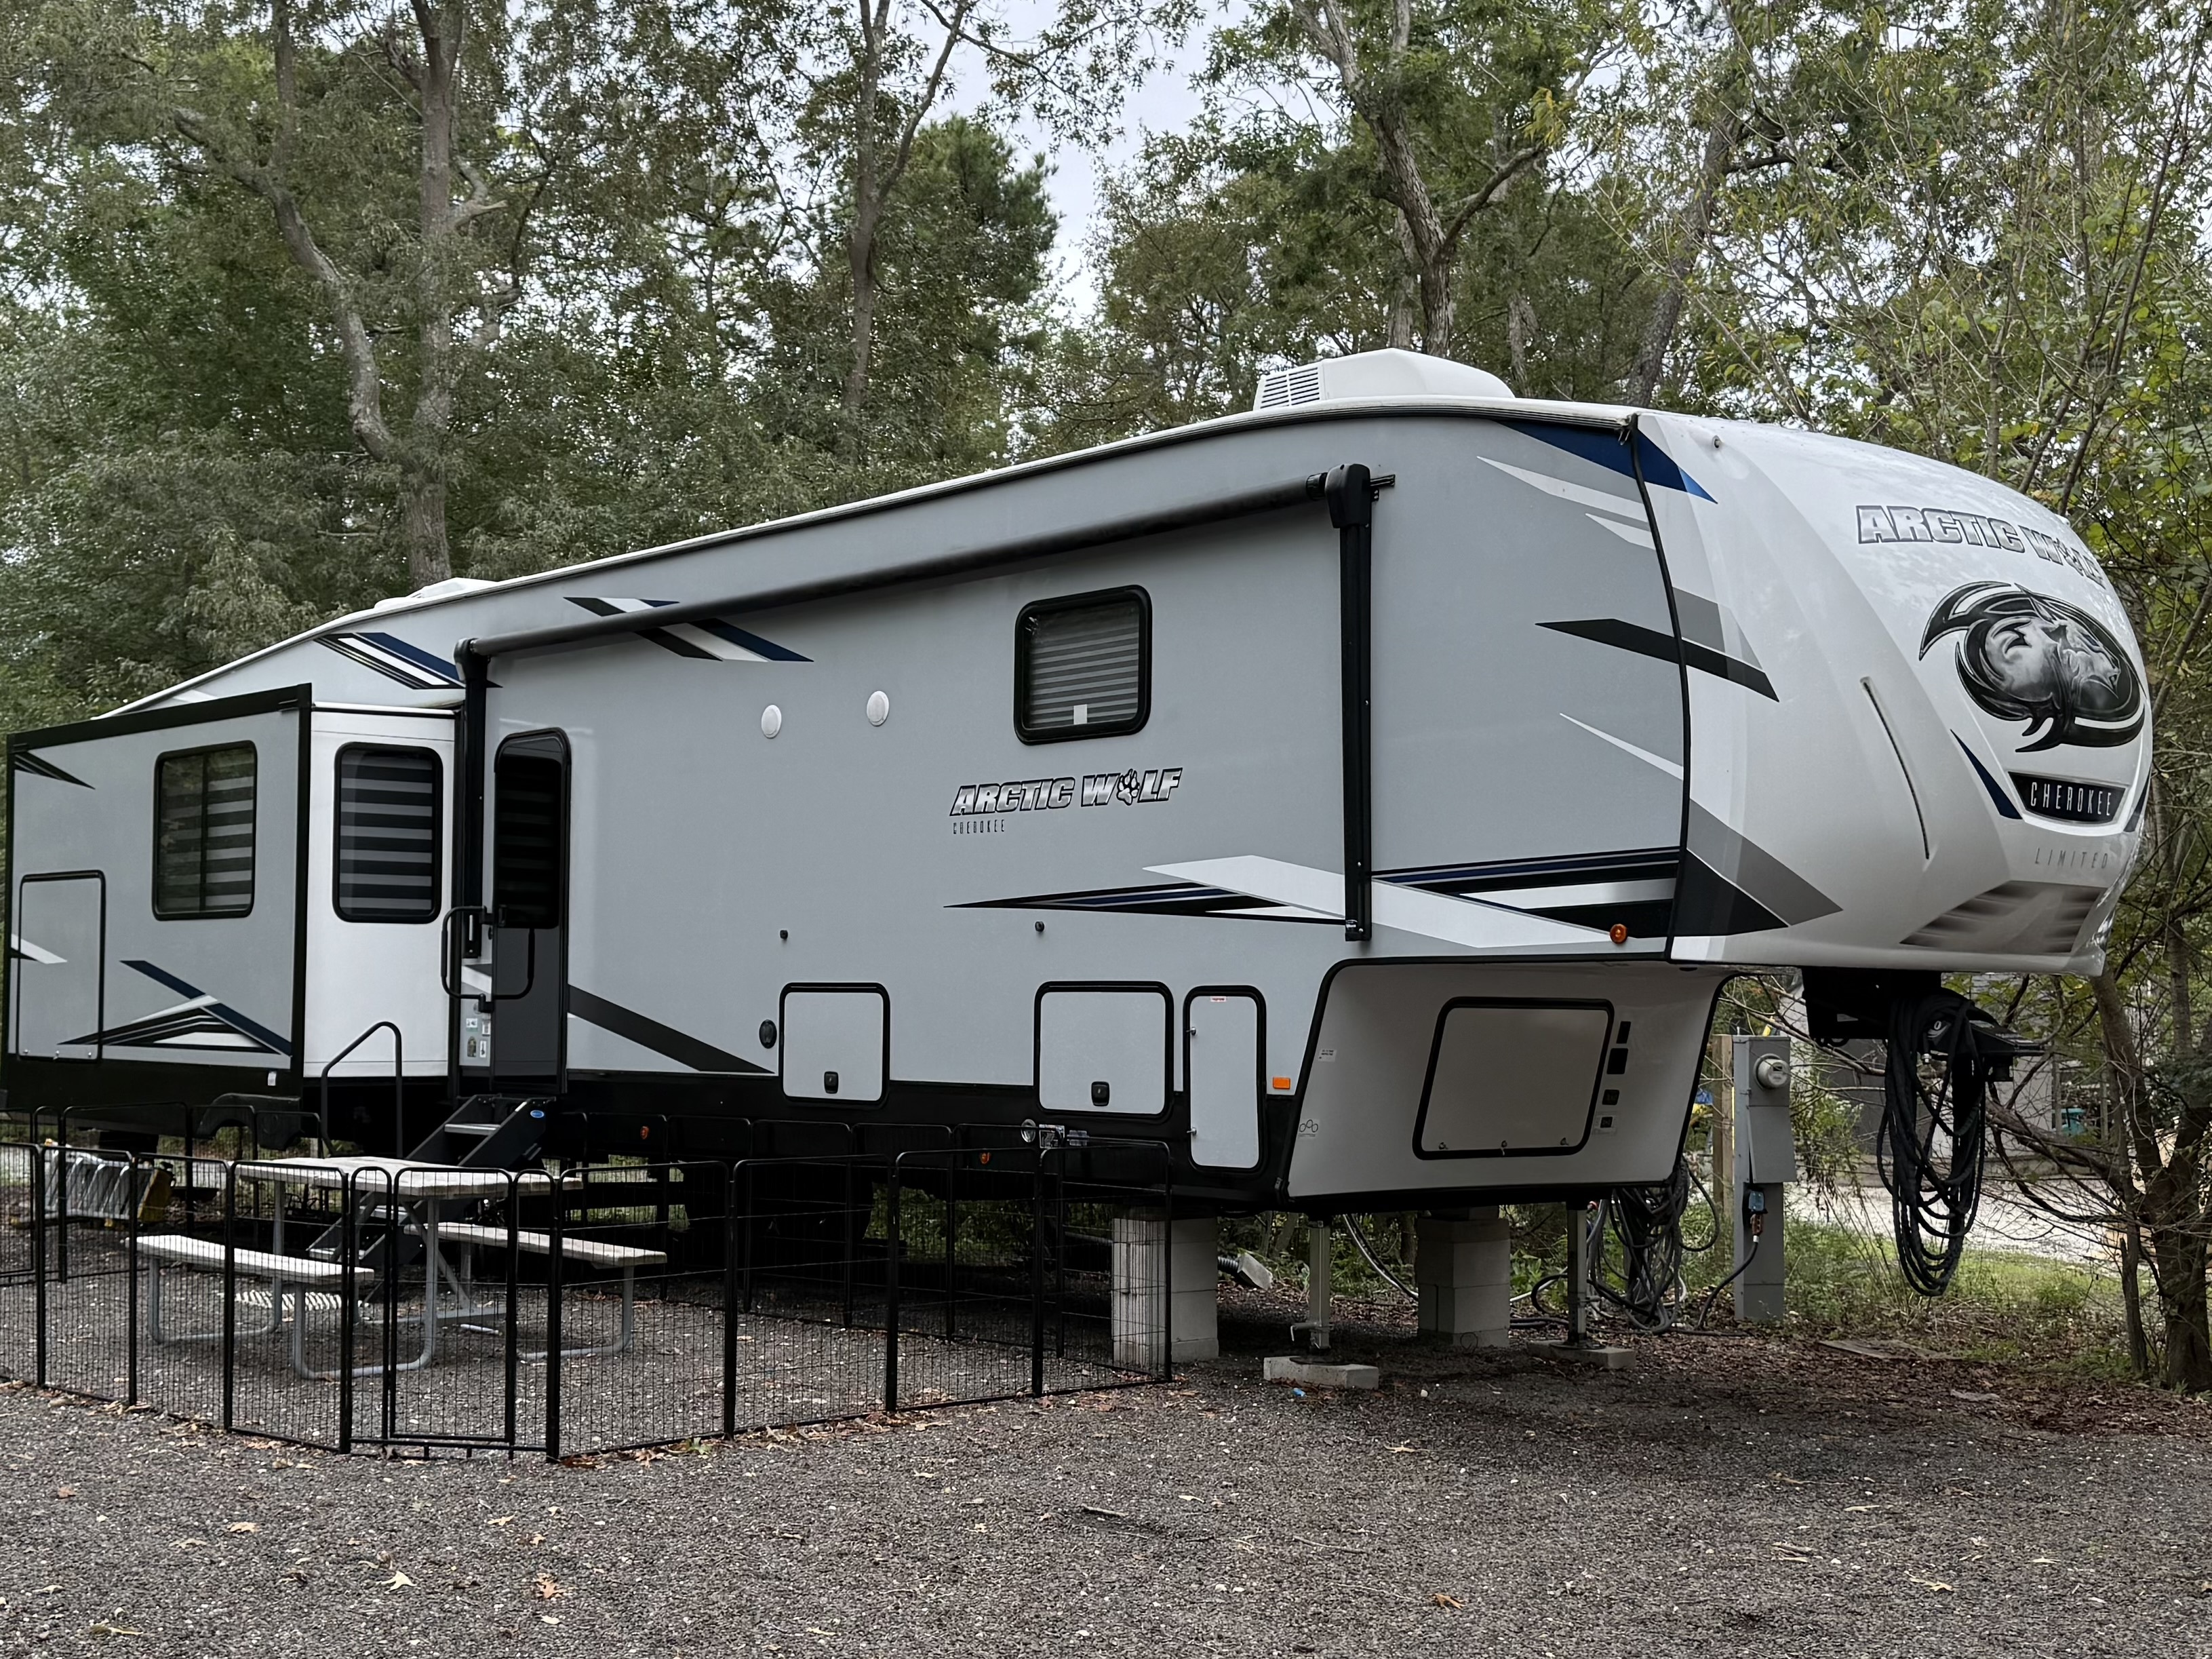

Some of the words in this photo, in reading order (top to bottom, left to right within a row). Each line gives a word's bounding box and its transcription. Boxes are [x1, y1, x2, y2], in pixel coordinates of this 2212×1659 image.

[1855, 505, 2026, 553] ARCTIC
[949, 777, 1075, 817] ARCTIC
[2030, 781, 2112, 816] CHEROKEE
[953, 819, 1005, 834] CHEROKEE
[2034, 847, 2108, 869] LIMITED
